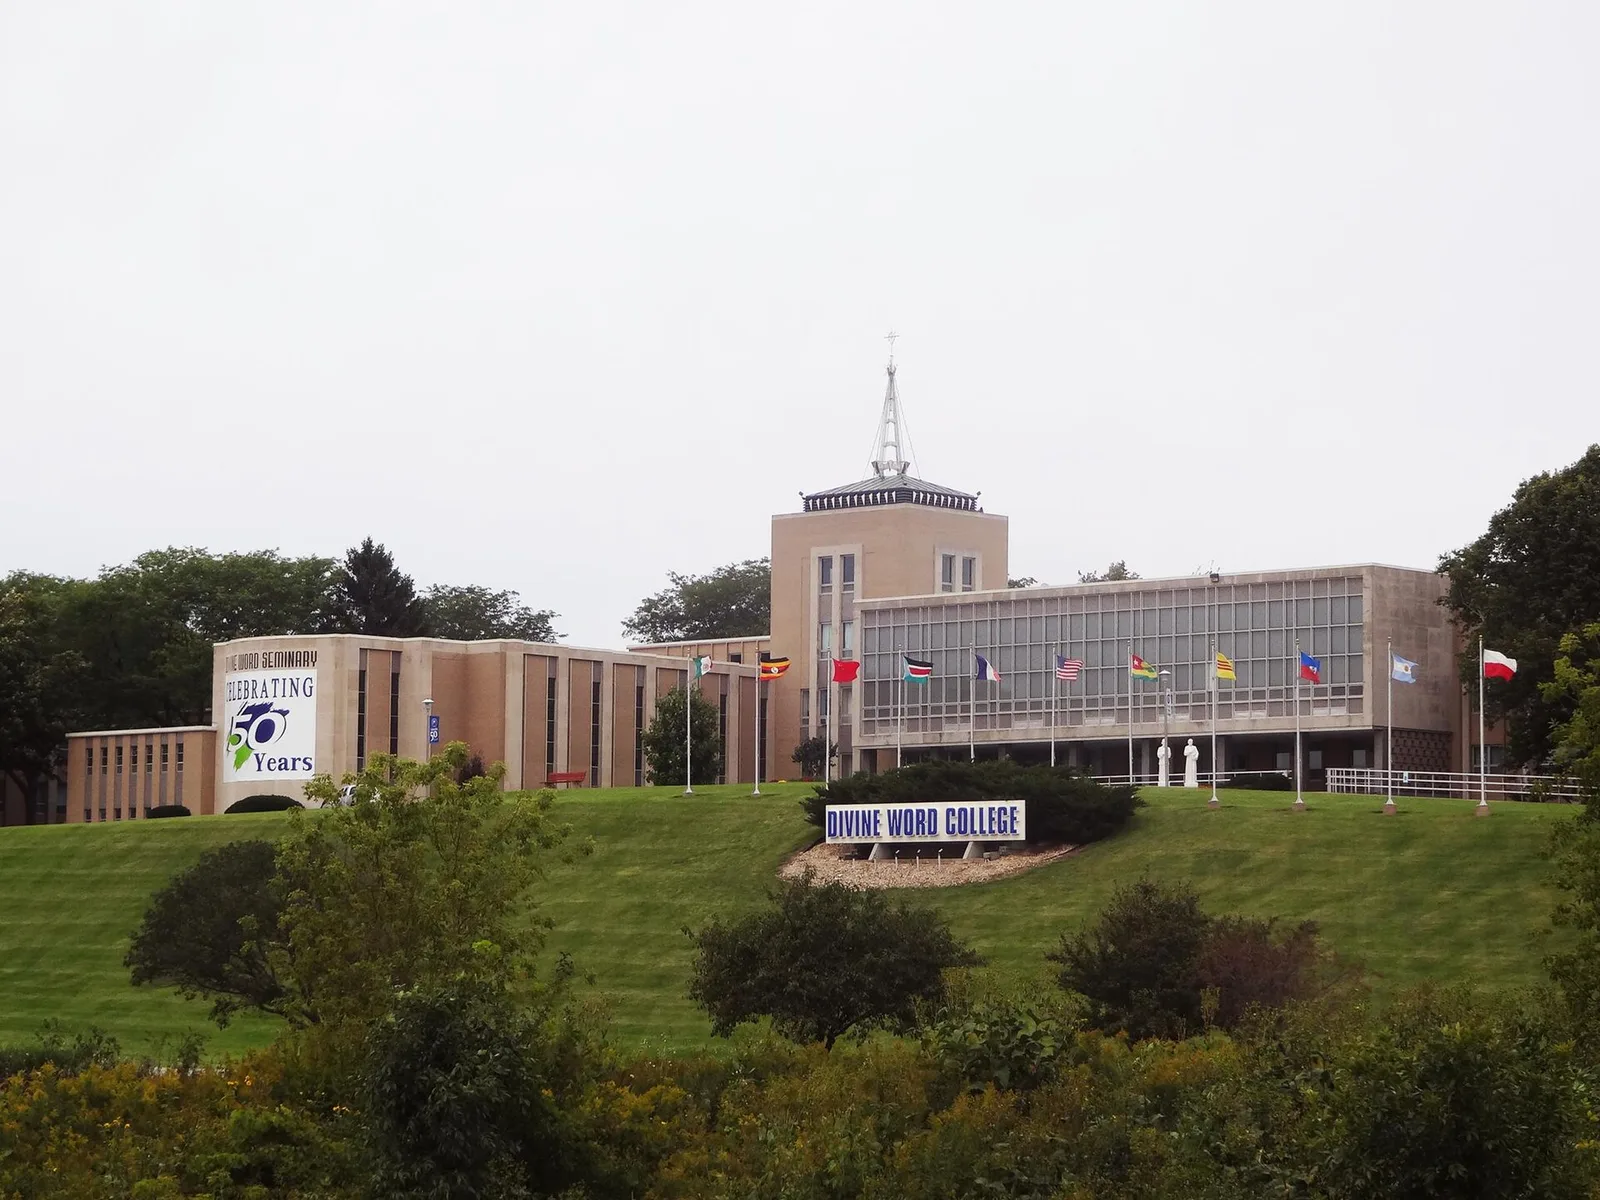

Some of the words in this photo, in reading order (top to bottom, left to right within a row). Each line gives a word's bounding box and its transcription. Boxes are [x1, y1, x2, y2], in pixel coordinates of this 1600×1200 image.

[238, 652, 259, 671] WORD
[261, 650, 318, 669] SEMINARY
[254, 752, 313, 772] Years
[828, 809, 881, 837] DIVINE
[887, 808, 939, 837] WORD
[945, 806, 1018, 835] COLLEGE
